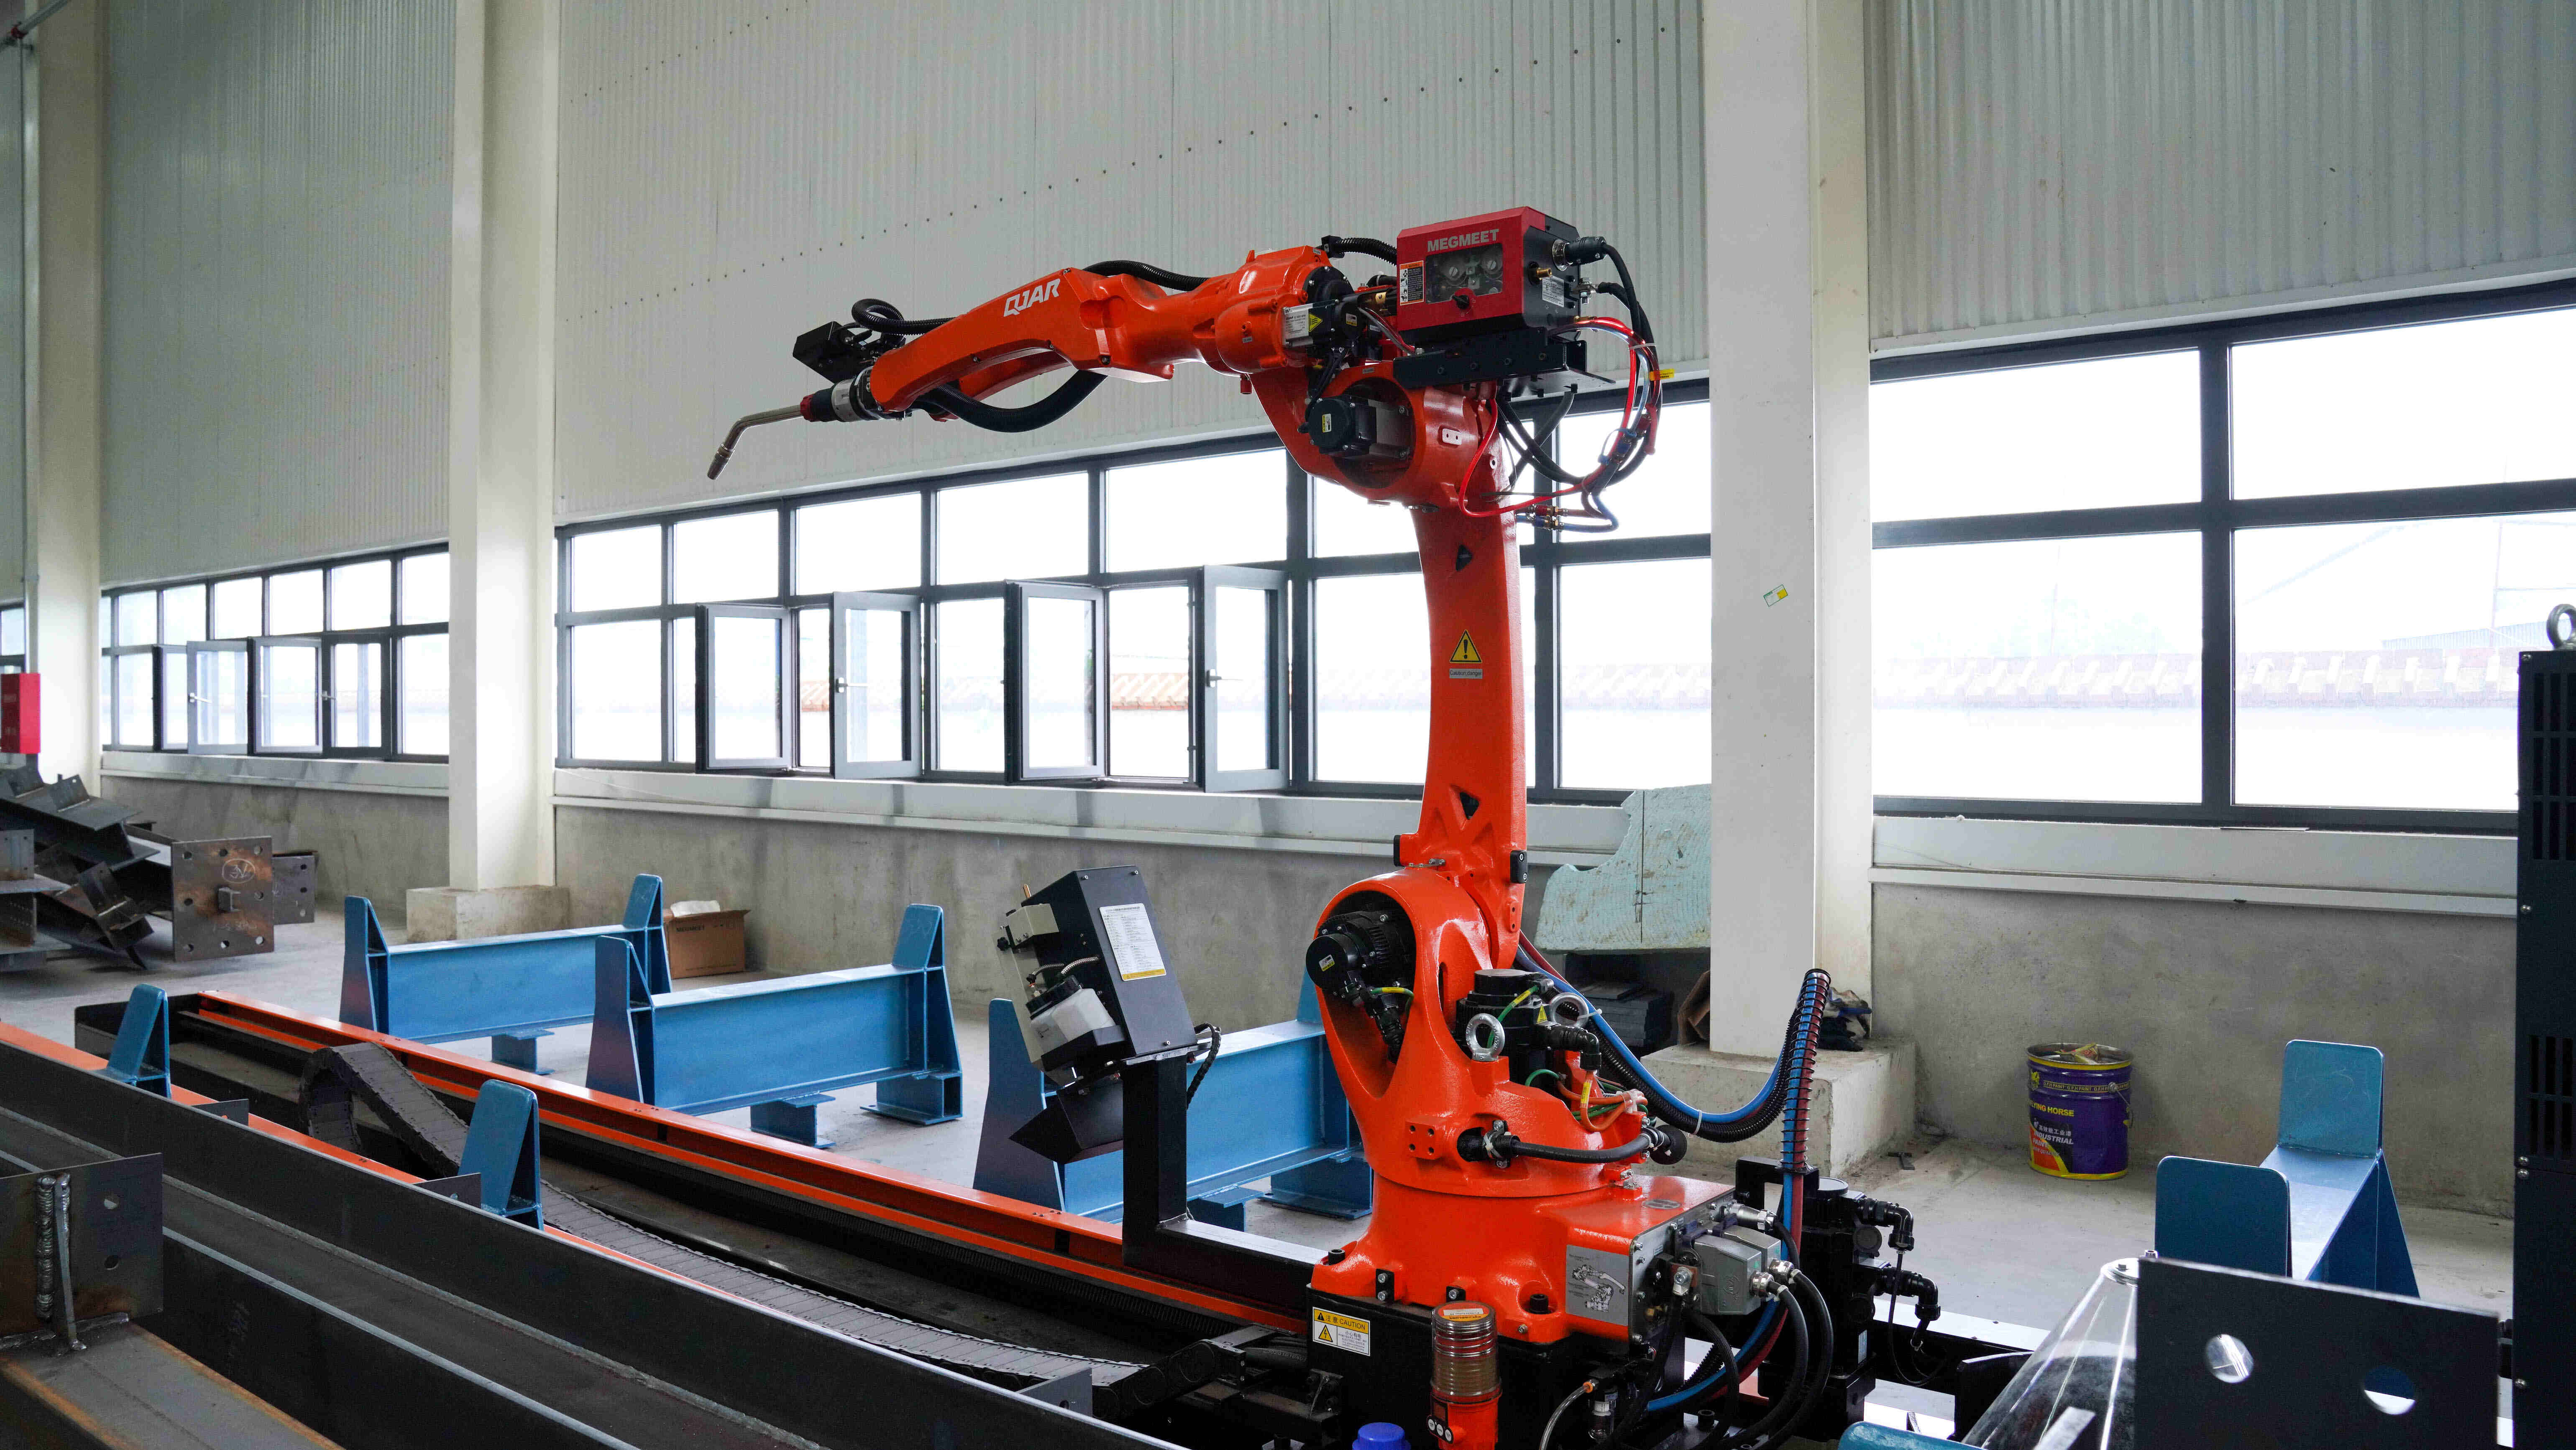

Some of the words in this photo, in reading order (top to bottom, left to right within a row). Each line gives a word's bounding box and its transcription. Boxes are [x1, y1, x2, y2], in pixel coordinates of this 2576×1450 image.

[1427, 229, 1499, 252] MEGMEET
[1004, 278, 1061, 317] QJAR
[2047, 1107, 2075, 1117] HORSE
[2035, 1131, 2074, 1145] INDUSTRIAL
[1325, 1314, 1338, 1323] 注意
[1340, 1318, 1366, 1330] CAUTION
